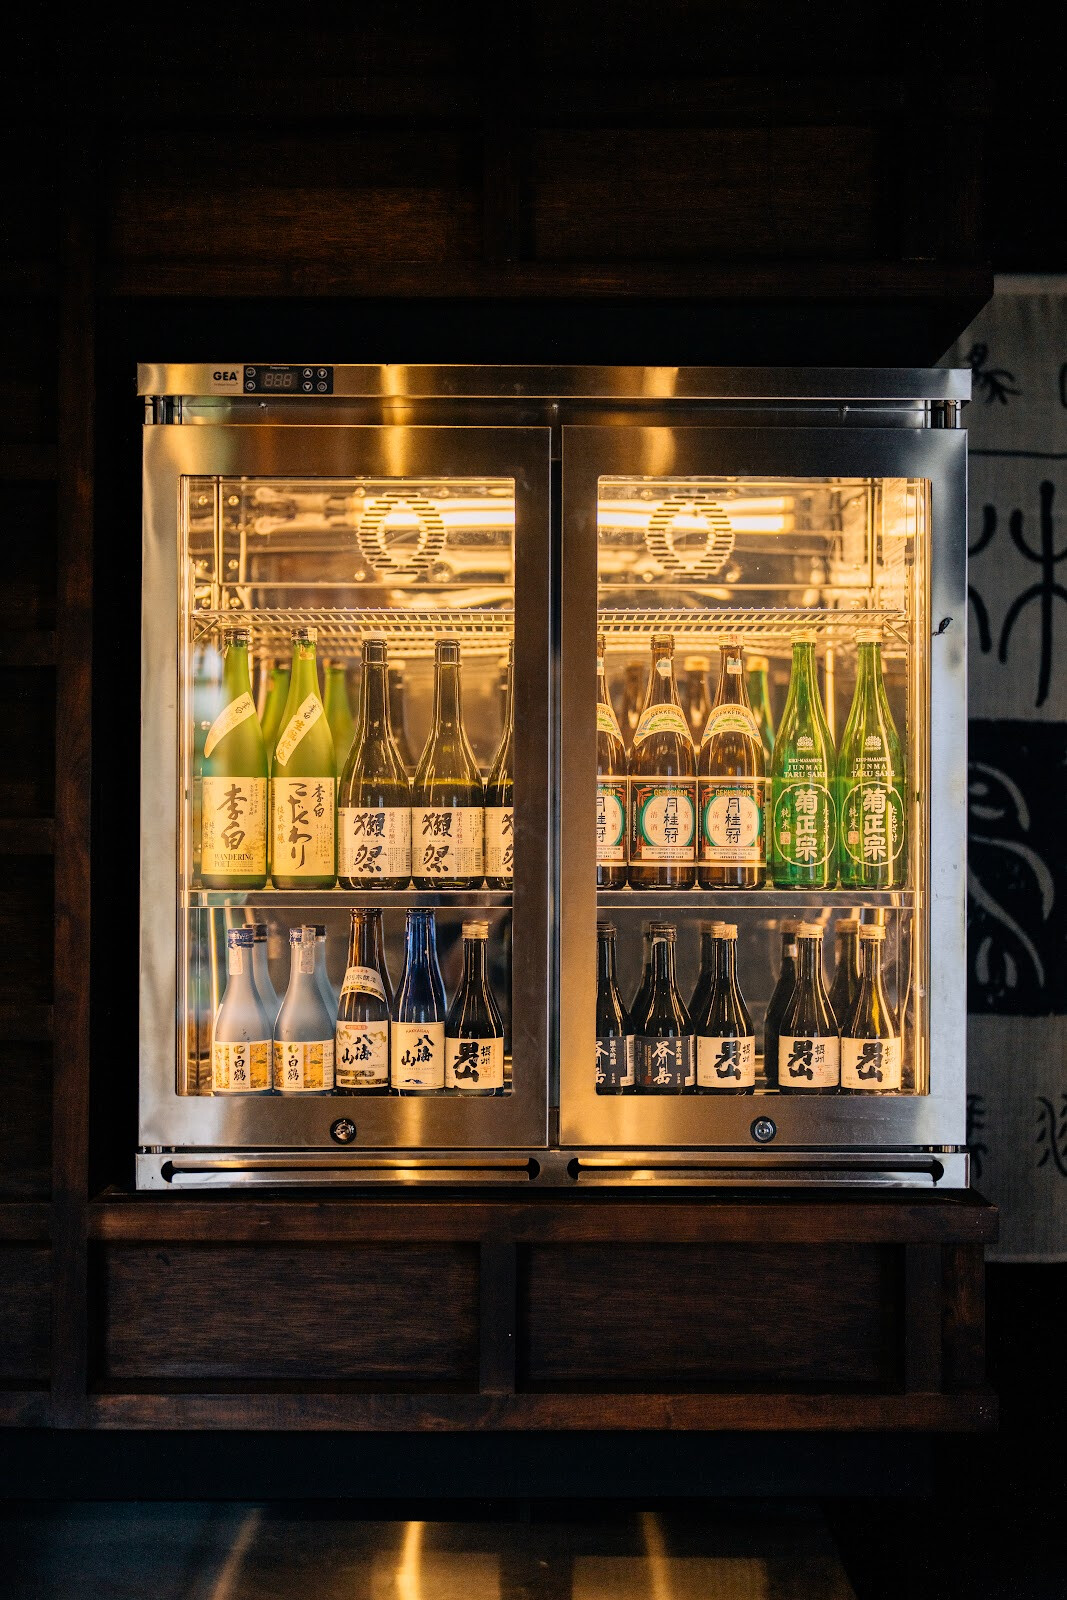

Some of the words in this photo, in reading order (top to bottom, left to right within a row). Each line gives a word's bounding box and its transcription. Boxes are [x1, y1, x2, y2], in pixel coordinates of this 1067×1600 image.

[213, 372, 237, 380] GEA
[216, 784, 248, 850] 李白
[312, 784, 326, 818] 李白
[663, 797, 679, 844] 月桂冠
[780, 808, 791, 830] 純米
[848, 808, 858, 830] 純米
[725, 798, 741, 844] 月桂冠
[794, 788, 818, 861] 菊正宗
[862, 788, 886, 860] 菊正宗
[354, 812, 387, 873] 獺祭
[422, 812, 454, 873] 獺祭
[234, 1055, 246, 1080] 白鶴
[288, 1055, 299, 1080] 白鶴
[342, 1034, 374, 1064] 八海山
[401, 1034, 434, 1066] 八海山
[652, 1040, 675, 1084] 谷川岳
